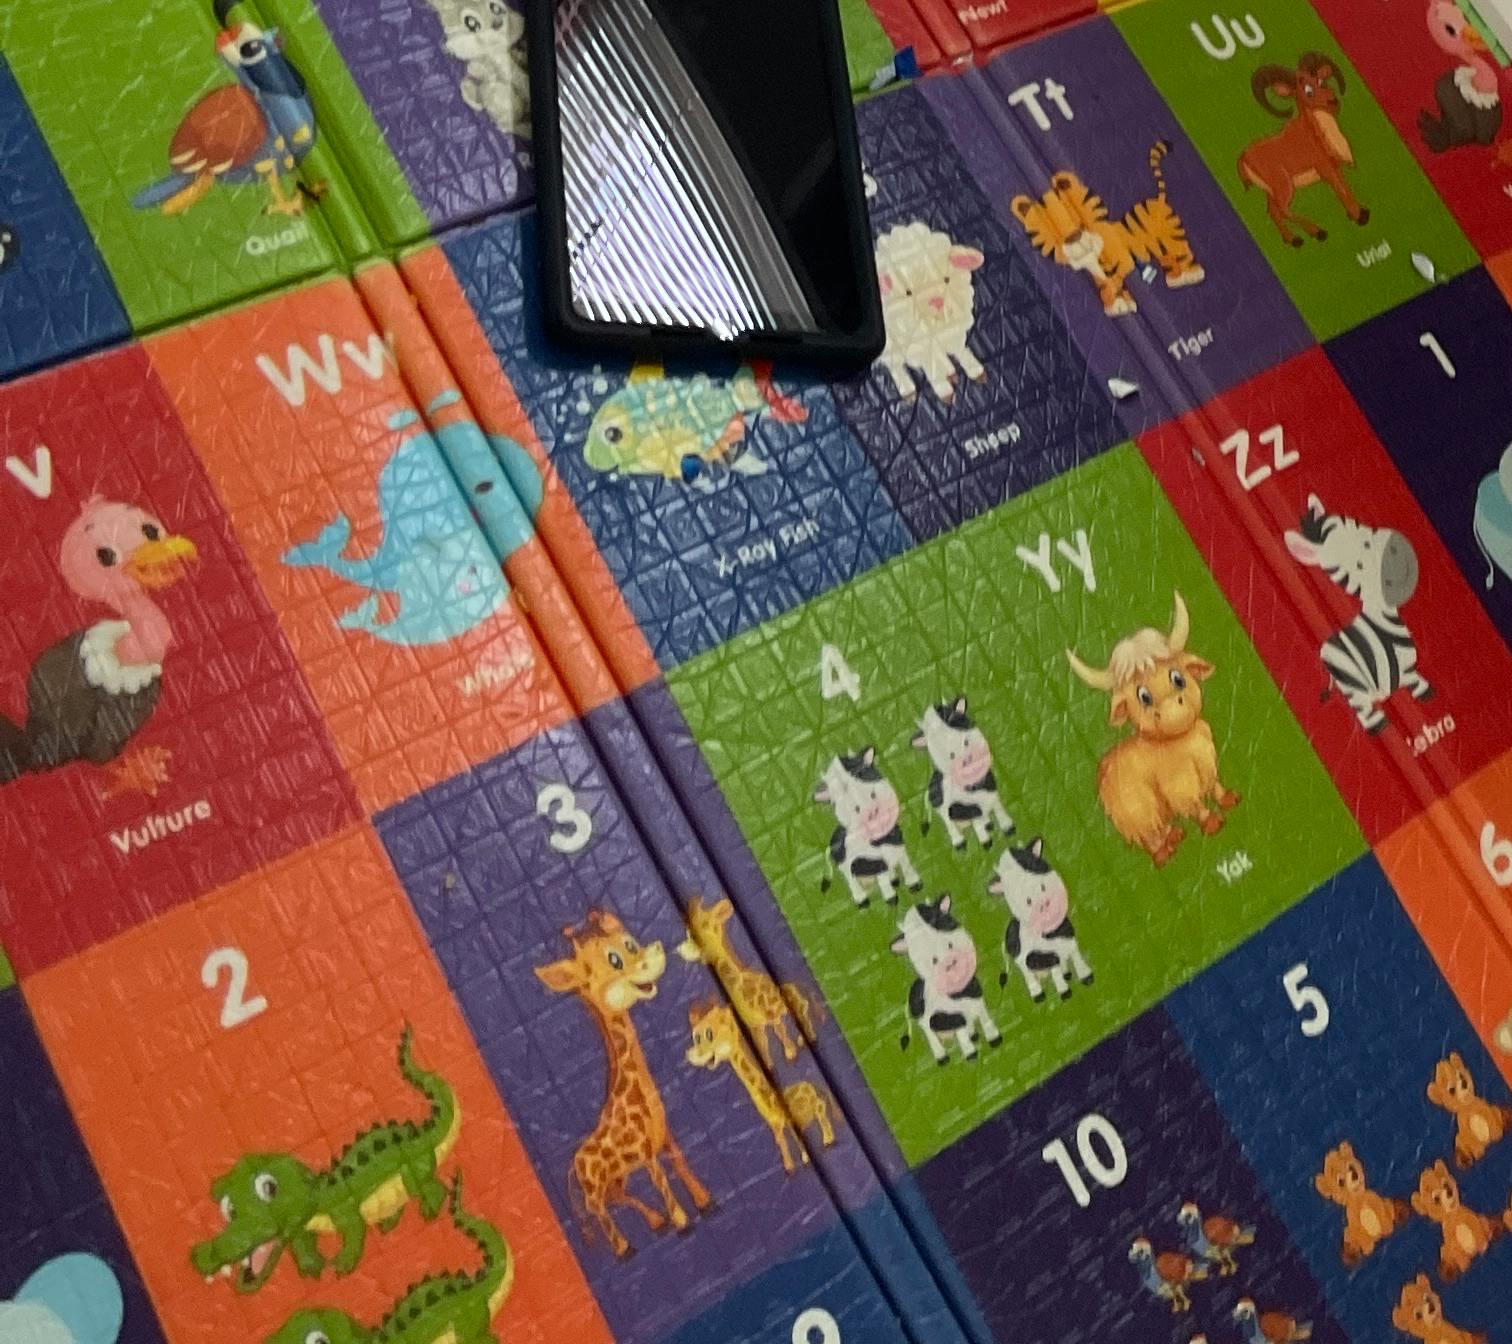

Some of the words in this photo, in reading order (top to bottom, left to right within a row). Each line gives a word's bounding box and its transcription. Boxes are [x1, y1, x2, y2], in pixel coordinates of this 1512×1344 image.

[1189, 10, 1266, 63] Uu
[1007, 76, 1074, 132] Tt
[244, 224, 312, 258] Quail
[1355, 240, 1393, 271] Urial
[255, 333, 402, 407] Ww
[1166, 326, 1216, 363] Tiger
[1418, 330, 1457, 379] 1
[962, 420, 1022, 461] Sheep
[1220, 422, 1301, 492] Zz
[778, 518, 821, 548] Fish
[1016, 528, 1097, 594] Yy
[819, 644, 861, 703] 4
[1403, 714, 1456, 758] ebra
[108, 797, 213, 858] Vulture
[535, 782, 594, 855] 3
[1215, 849, 1254, 884] Yak
[201, 946, 269, 1030] 2
[1281, 961, 1331, 1039] 5
[1041, 1112, 1129, 1208] 10
